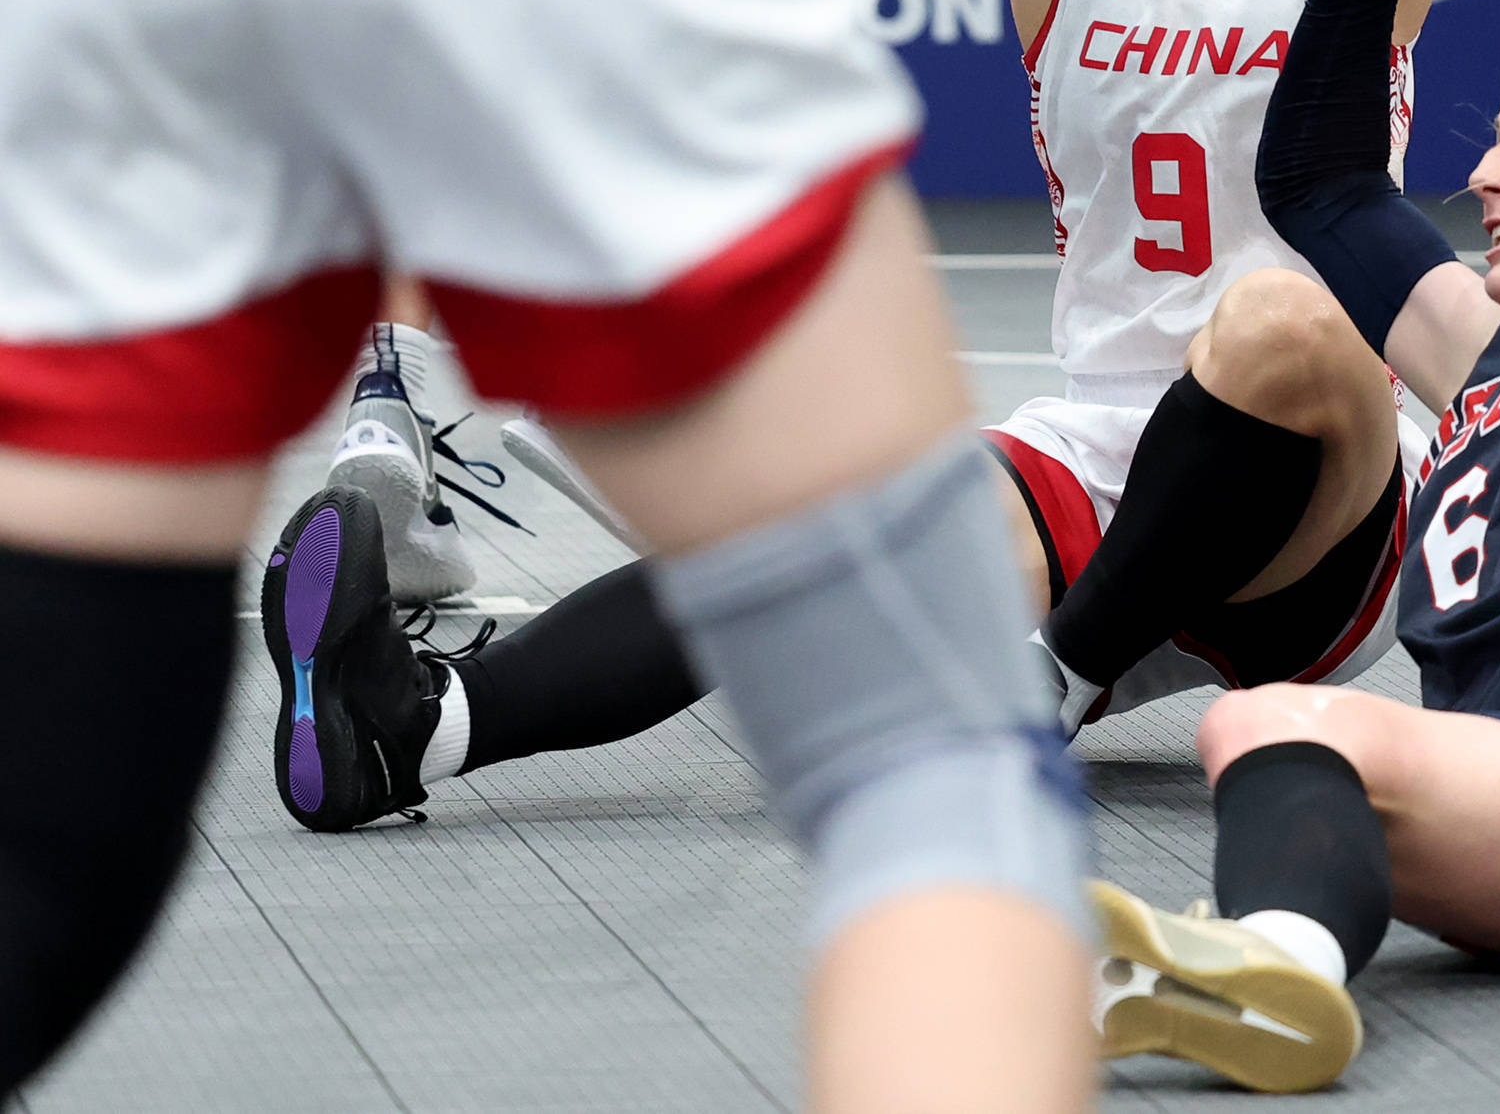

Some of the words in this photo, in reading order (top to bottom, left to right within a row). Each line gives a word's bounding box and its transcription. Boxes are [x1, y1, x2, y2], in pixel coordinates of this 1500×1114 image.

[1079, 20, 1291, 75] CHINA
[1132, 132, 1212, 277] 9
[1422, 463, 1491, 612] 6
